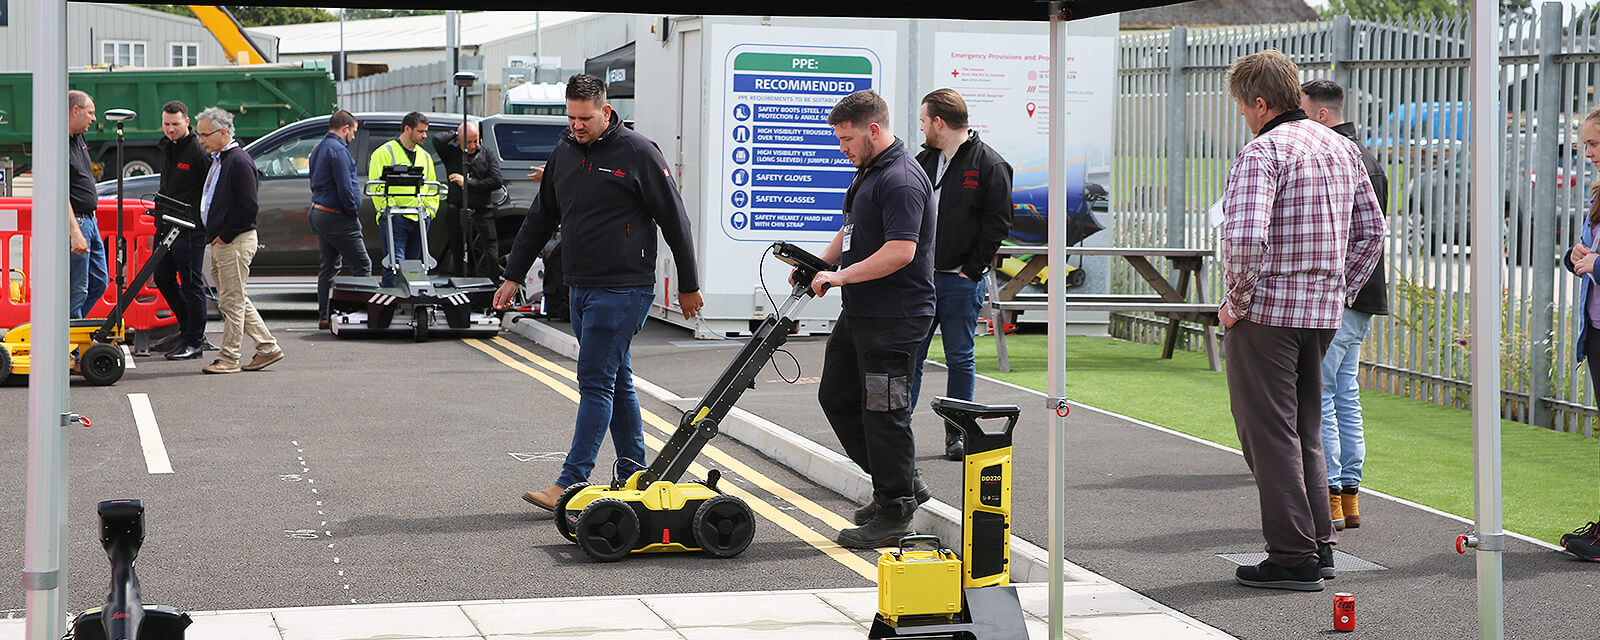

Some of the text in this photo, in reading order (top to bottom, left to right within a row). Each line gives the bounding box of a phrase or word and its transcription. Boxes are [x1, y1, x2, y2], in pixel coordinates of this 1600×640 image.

[951, 52, 986, 60] Emergency
[792, 58, 819, 69] PPE:
[755, 78, 855, 92] RECOMMENDED
[756, 173, 812, 182] SAFETY GLOVES
[755, 195, 816, 204] SAFETY GLASSES
